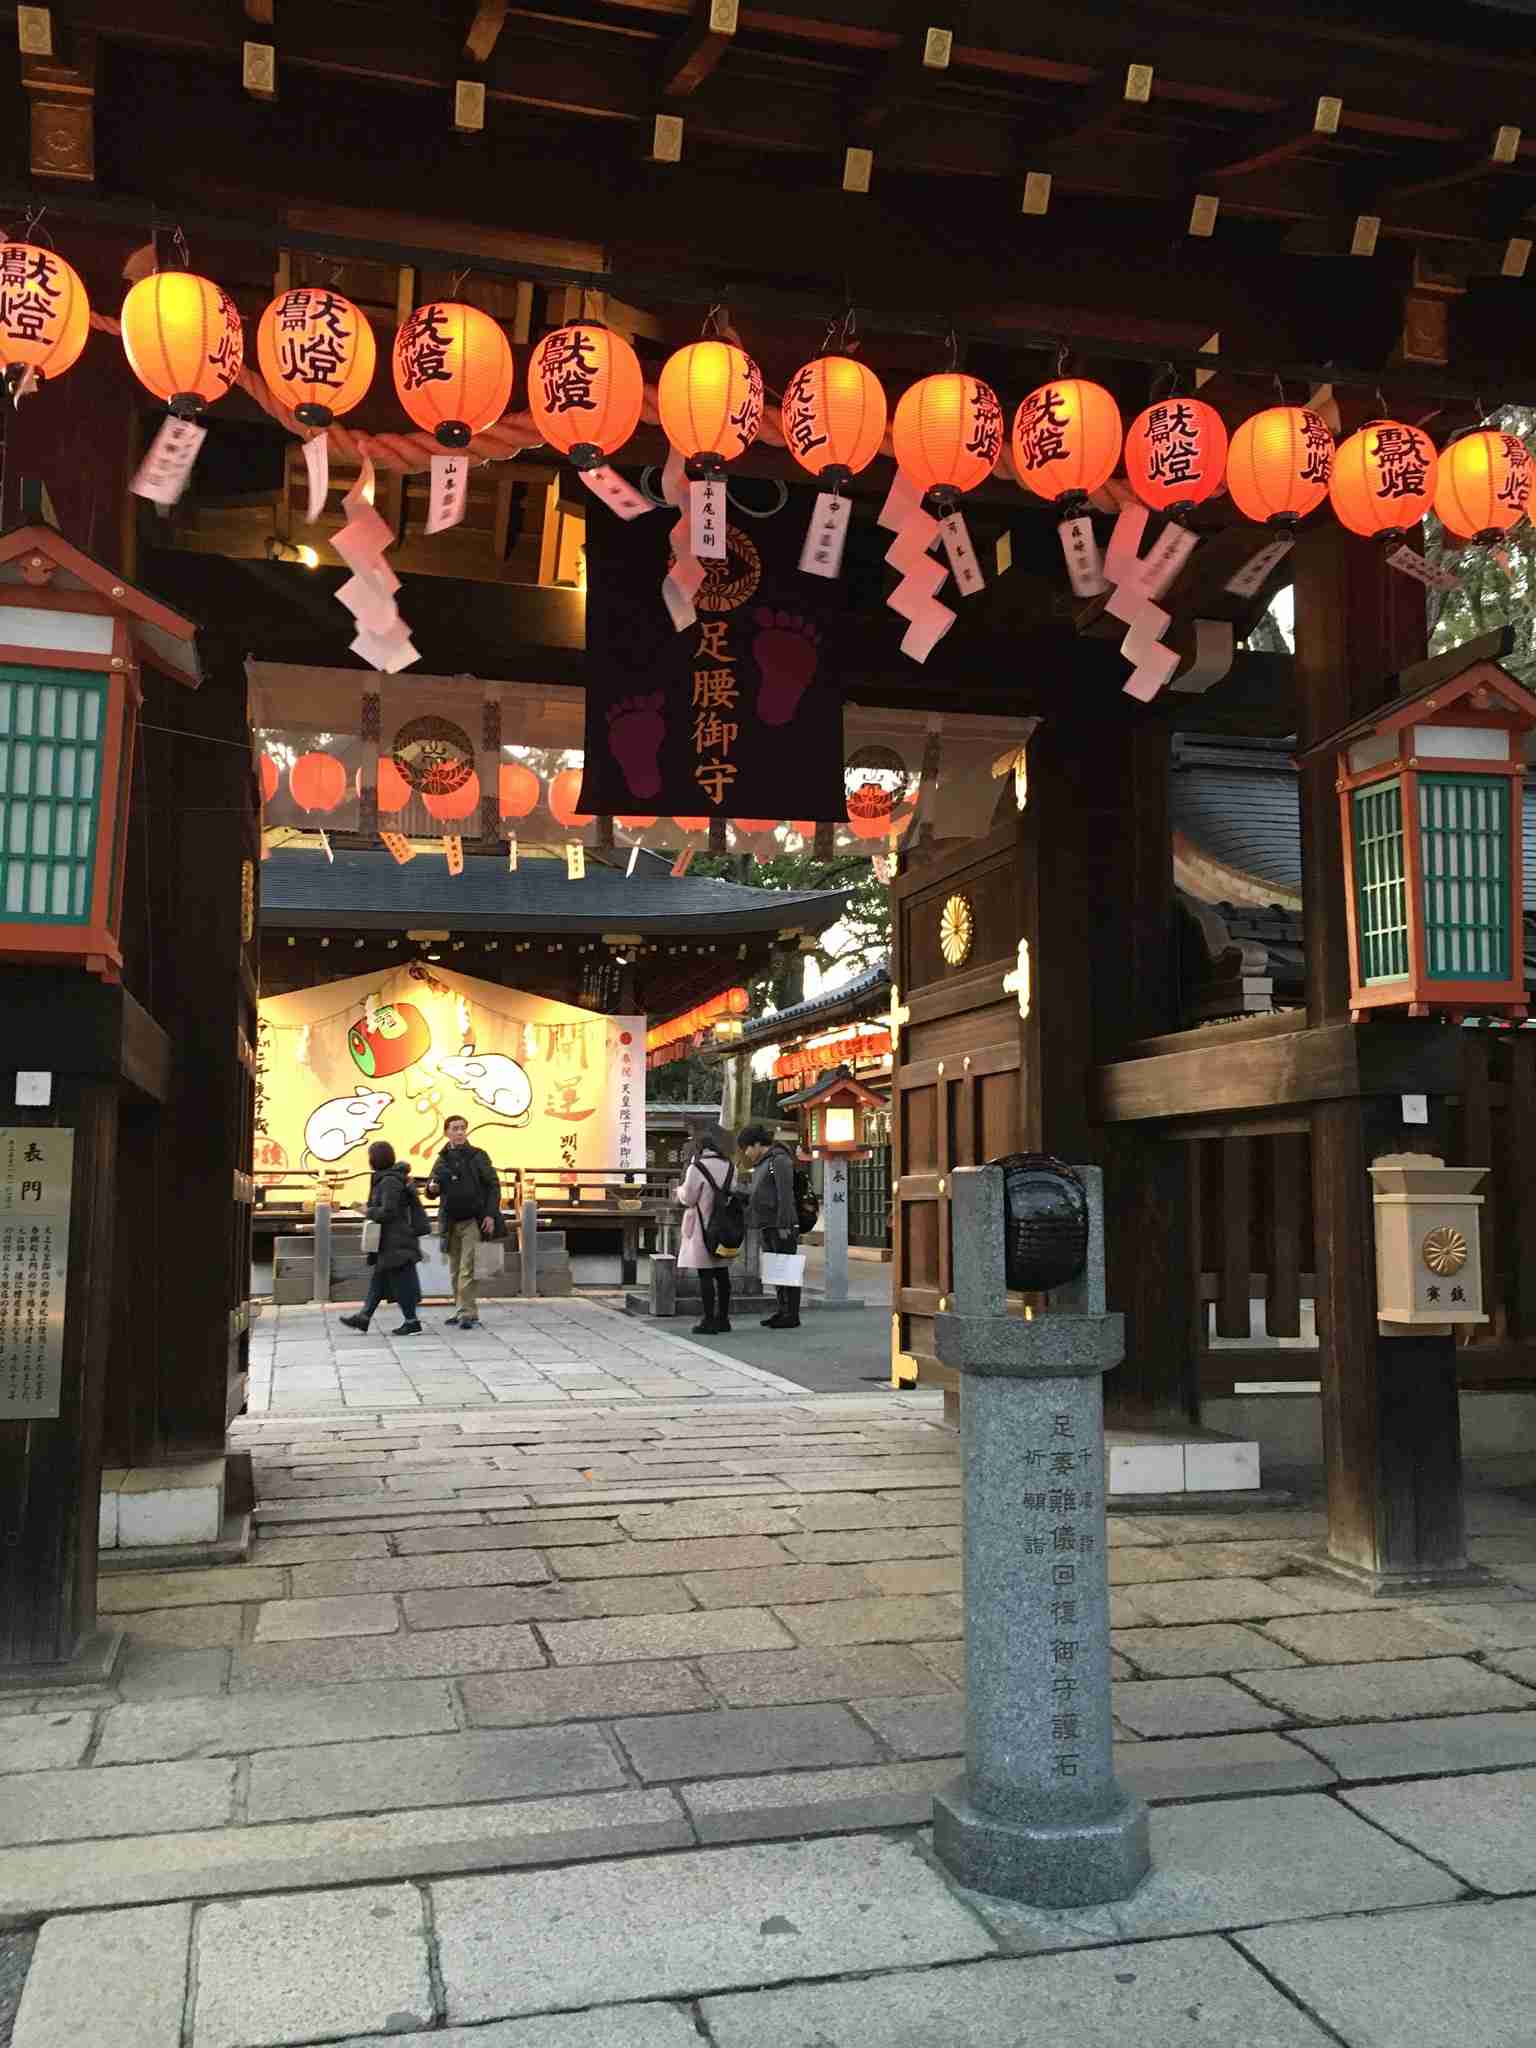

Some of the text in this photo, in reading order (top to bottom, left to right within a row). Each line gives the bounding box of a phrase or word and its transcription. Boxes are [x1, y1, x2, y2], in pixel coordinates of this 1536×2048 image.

[276, 290, 353, 389] 獻燈
[395, 305, 454, 390] 獻燈
[538, 331, 600, 412] 獻燈
[1015, 388, 1072, 470] 獻燈
[1142, 403, 1201, 486] 獻燈
[1370, 426, 1431, 499] 獻燈
[691, 621, 740, 805] 足腰御守
[21, 1142, 44, 1203] 表門
